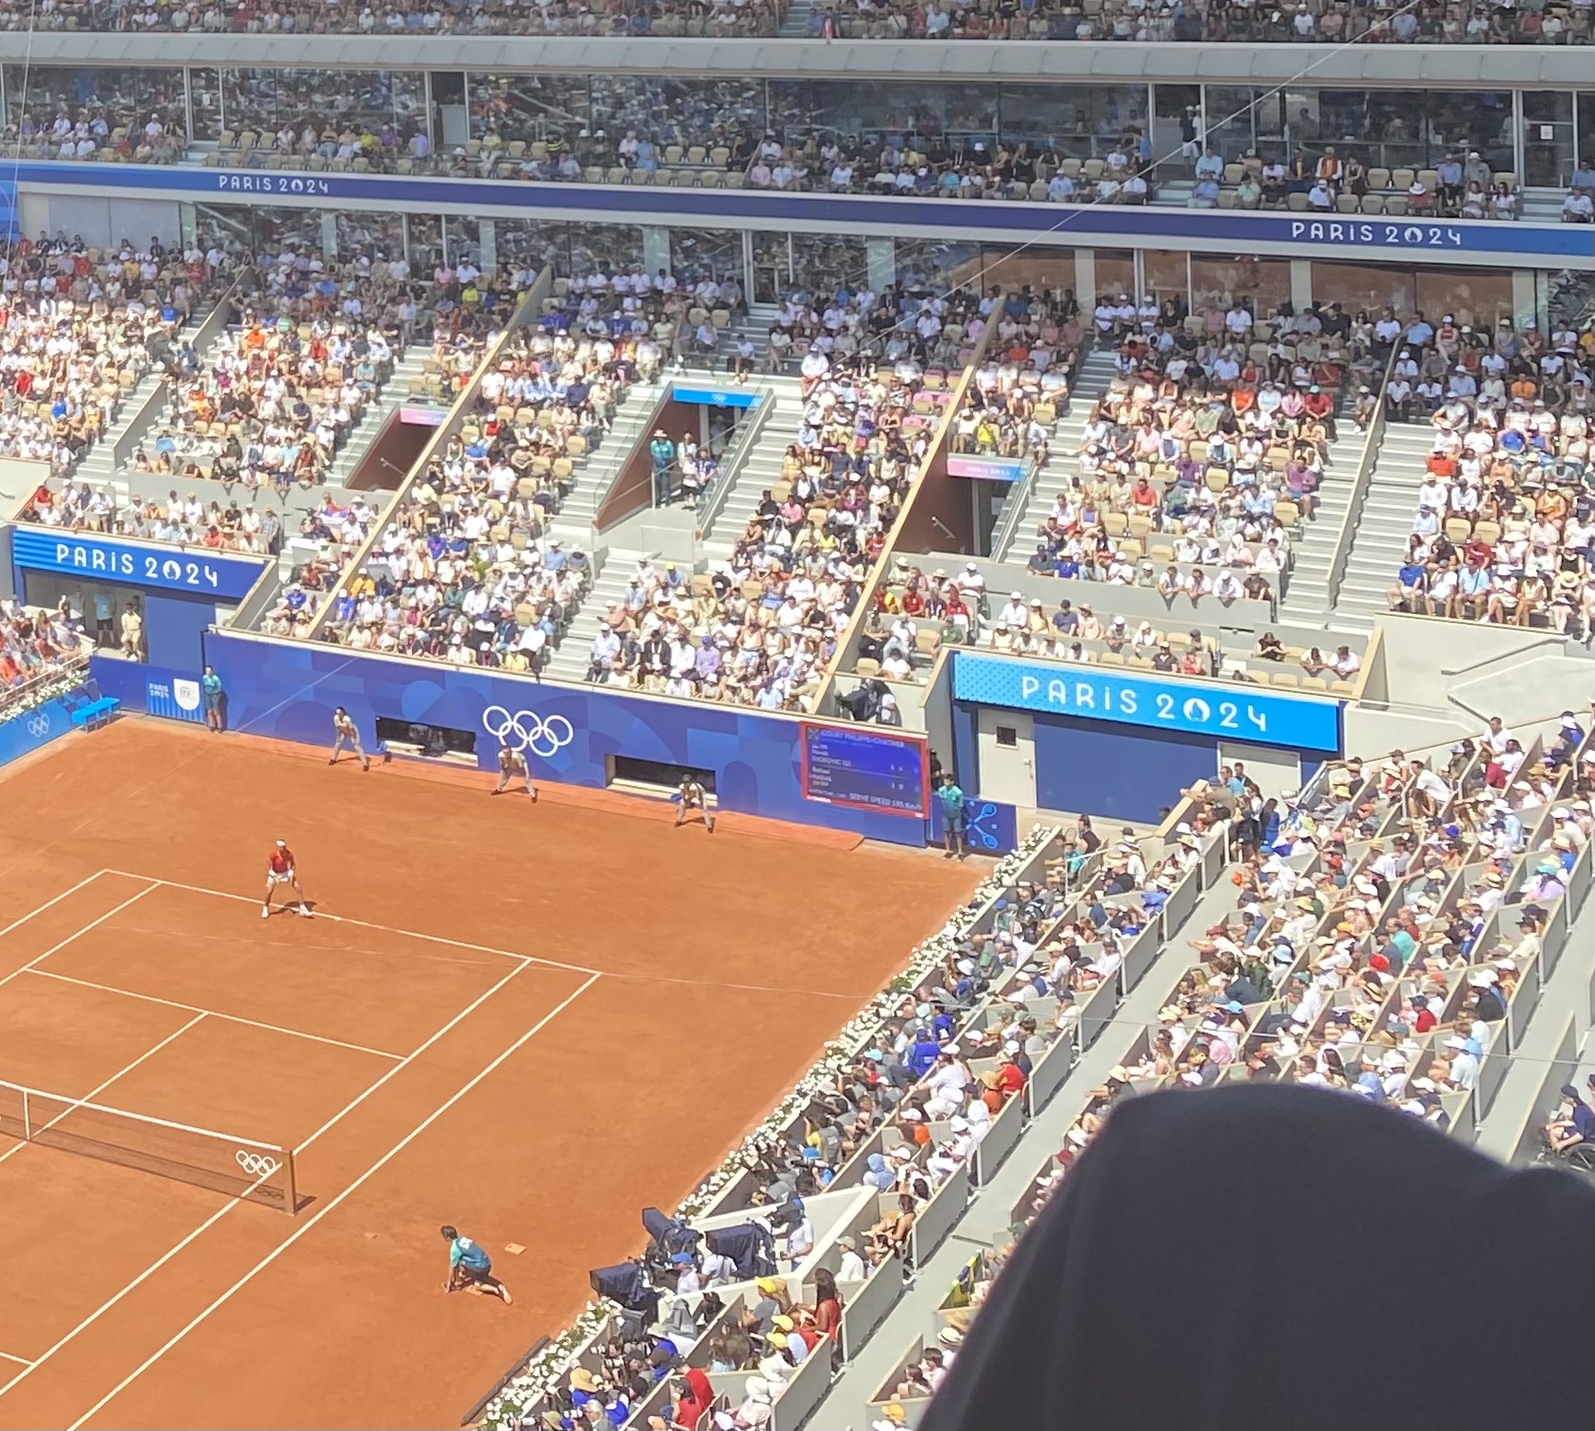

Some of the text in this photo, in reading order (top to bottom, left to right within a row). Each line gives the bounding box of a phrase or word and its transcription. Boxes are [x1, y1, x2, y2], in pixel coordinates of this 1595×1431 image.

[219, 175, 328, 193] PARIS 2024
[1292, 222, 1461, 245] PARIS 2024
[144, 557, 218, 587] 2024
[1156, 693, 1266, 732] 2024
